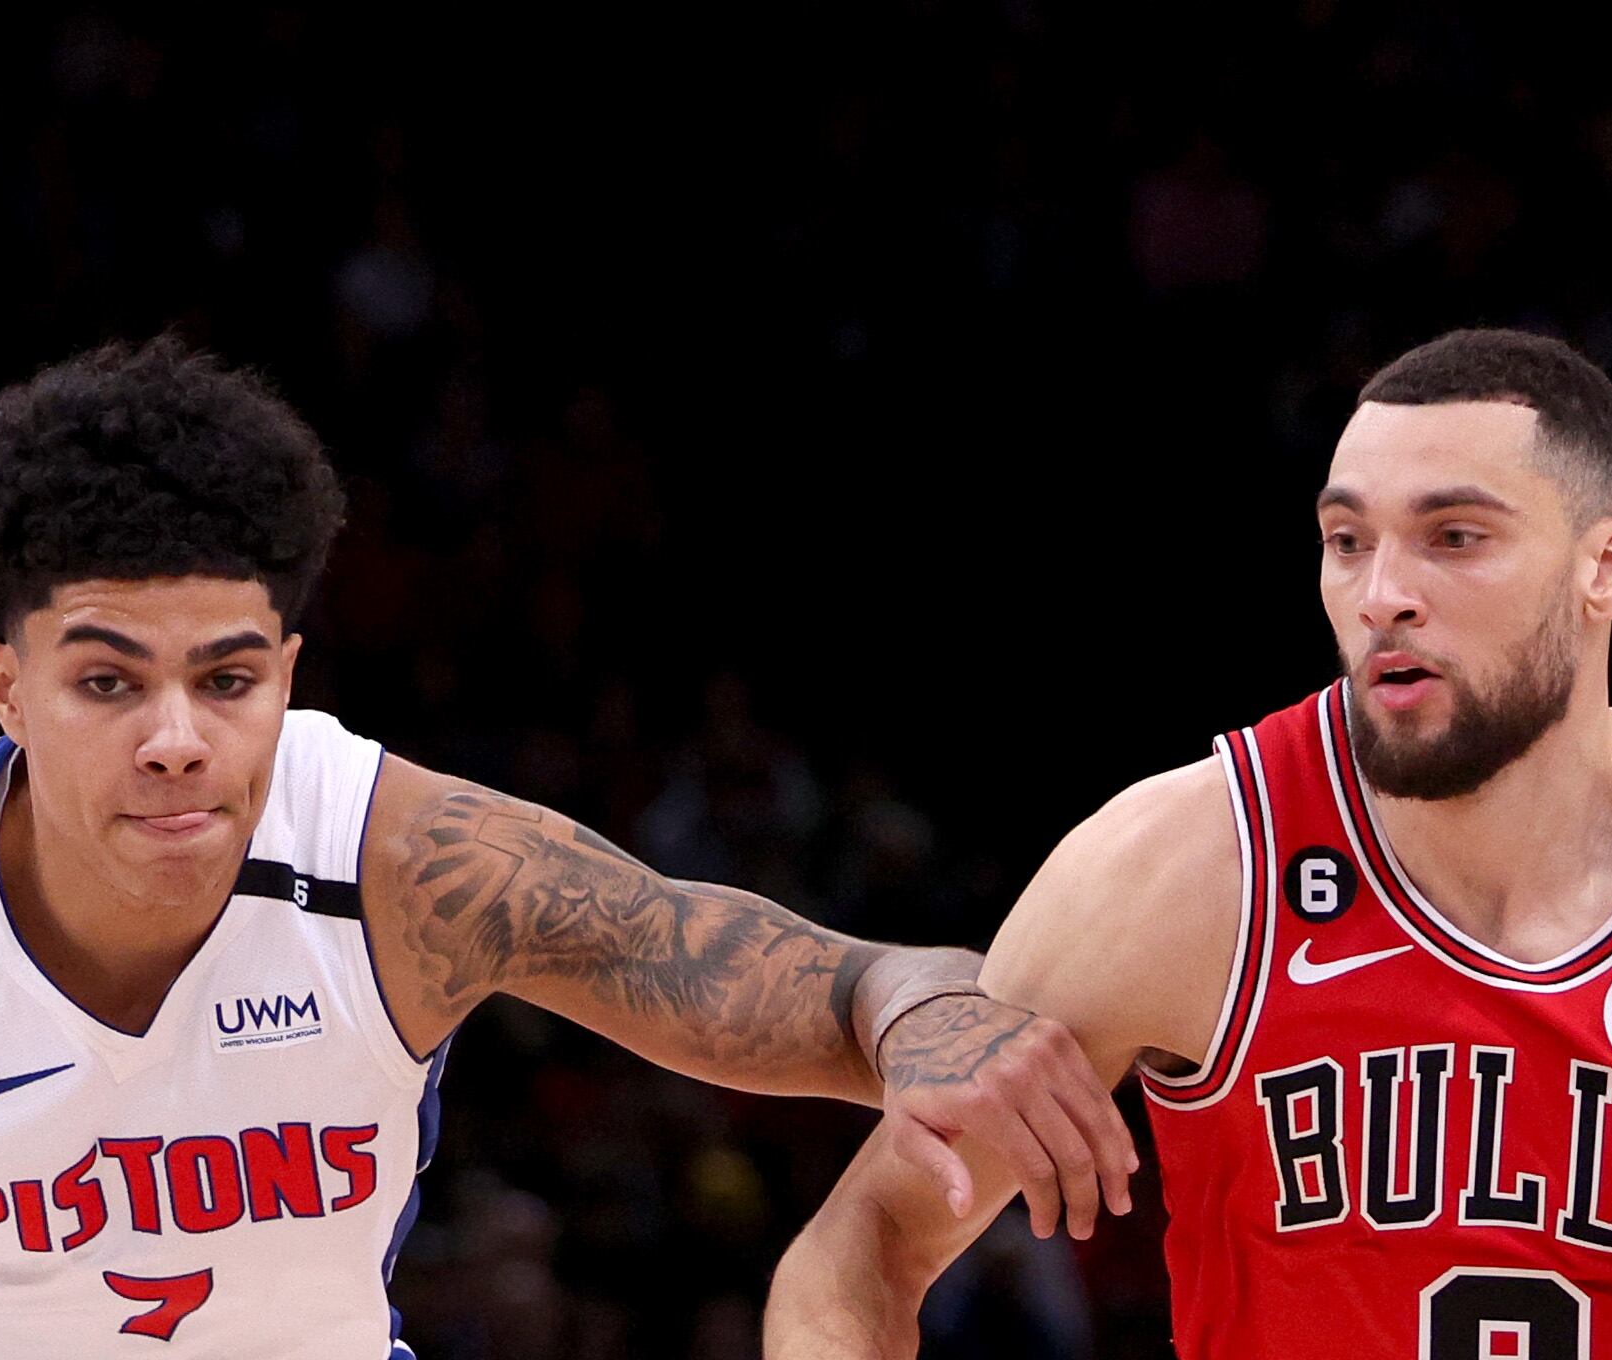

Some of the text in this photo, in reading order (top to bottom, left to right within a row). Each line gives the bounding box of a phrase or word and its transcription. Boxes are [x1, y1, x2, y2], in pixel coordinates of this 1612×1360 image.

[293, 879, 309, 907] 6
[1298, 857, 1339, 914] 6
[215, 989, 321, 1034] UWM
[220, 1027, 323, 1048] UNITED WHOLESALE MORTGAGE
[102, 1267, 213, 1342] 7
